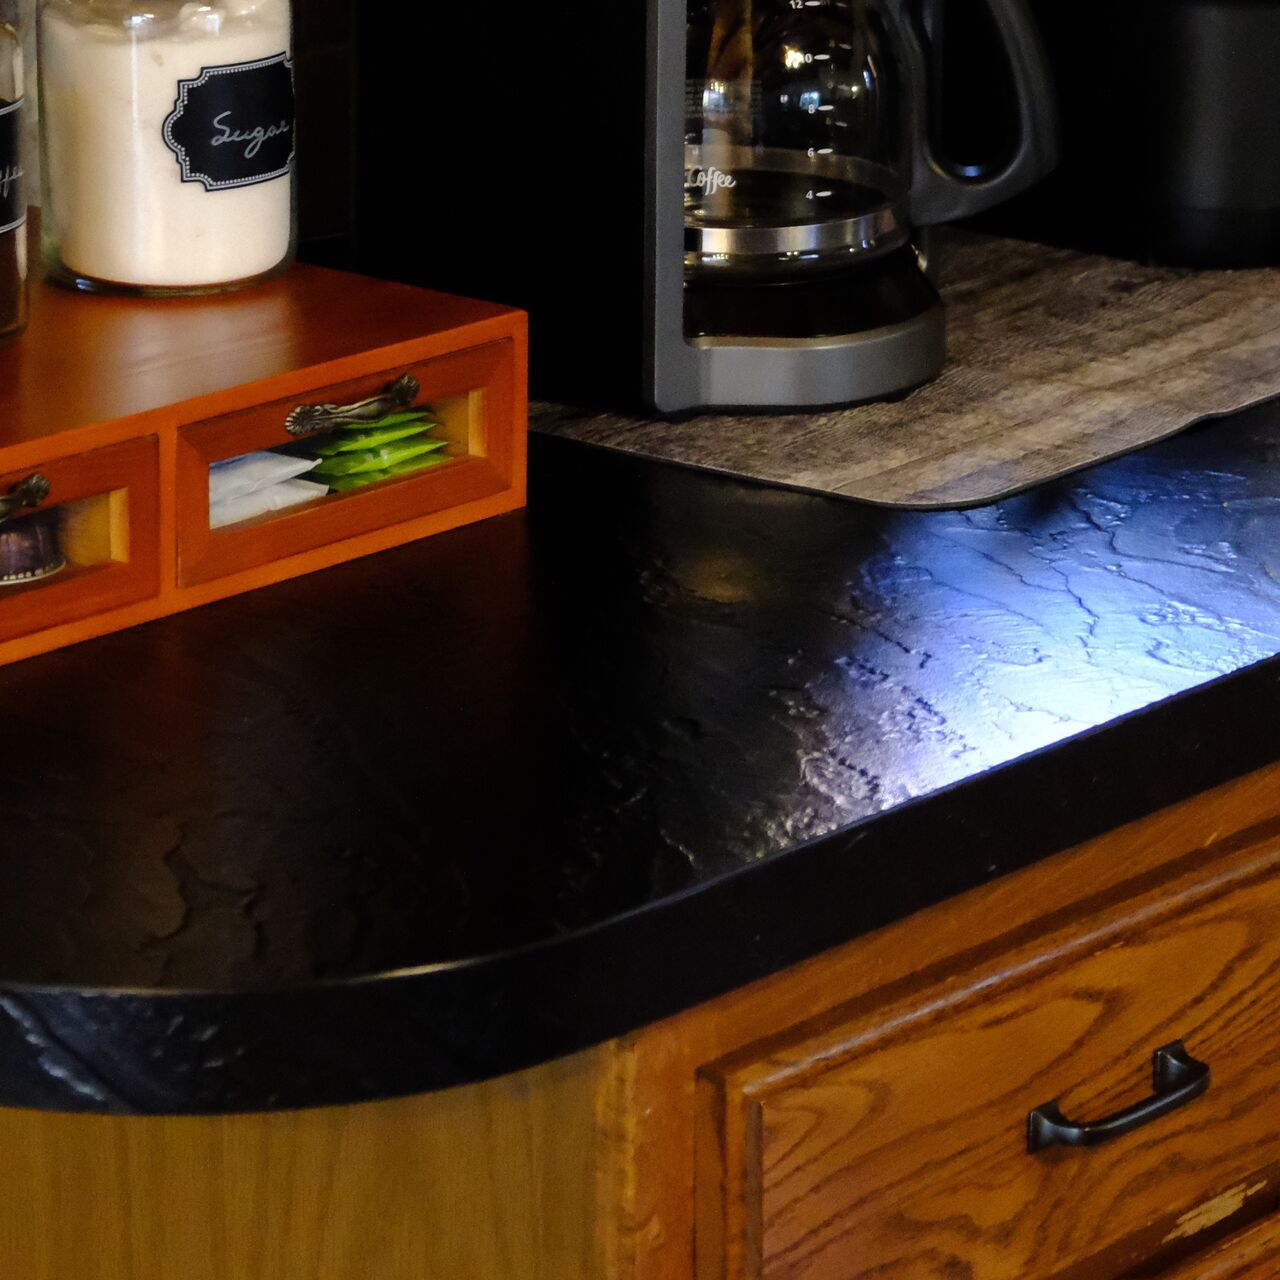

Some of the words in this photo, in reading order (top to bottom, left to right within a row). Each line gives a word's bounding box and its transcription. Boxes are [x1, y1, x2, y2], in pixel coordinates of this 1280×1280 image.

[789, 0, 803, 9] 12
[807, 103, 815, 114] 8
[211, 110, 289, 159] Sugar
[807, 147, 815, 157] 6
[687, 166, 736, 196] Coffee
[805, 190, 814, 200] 4
